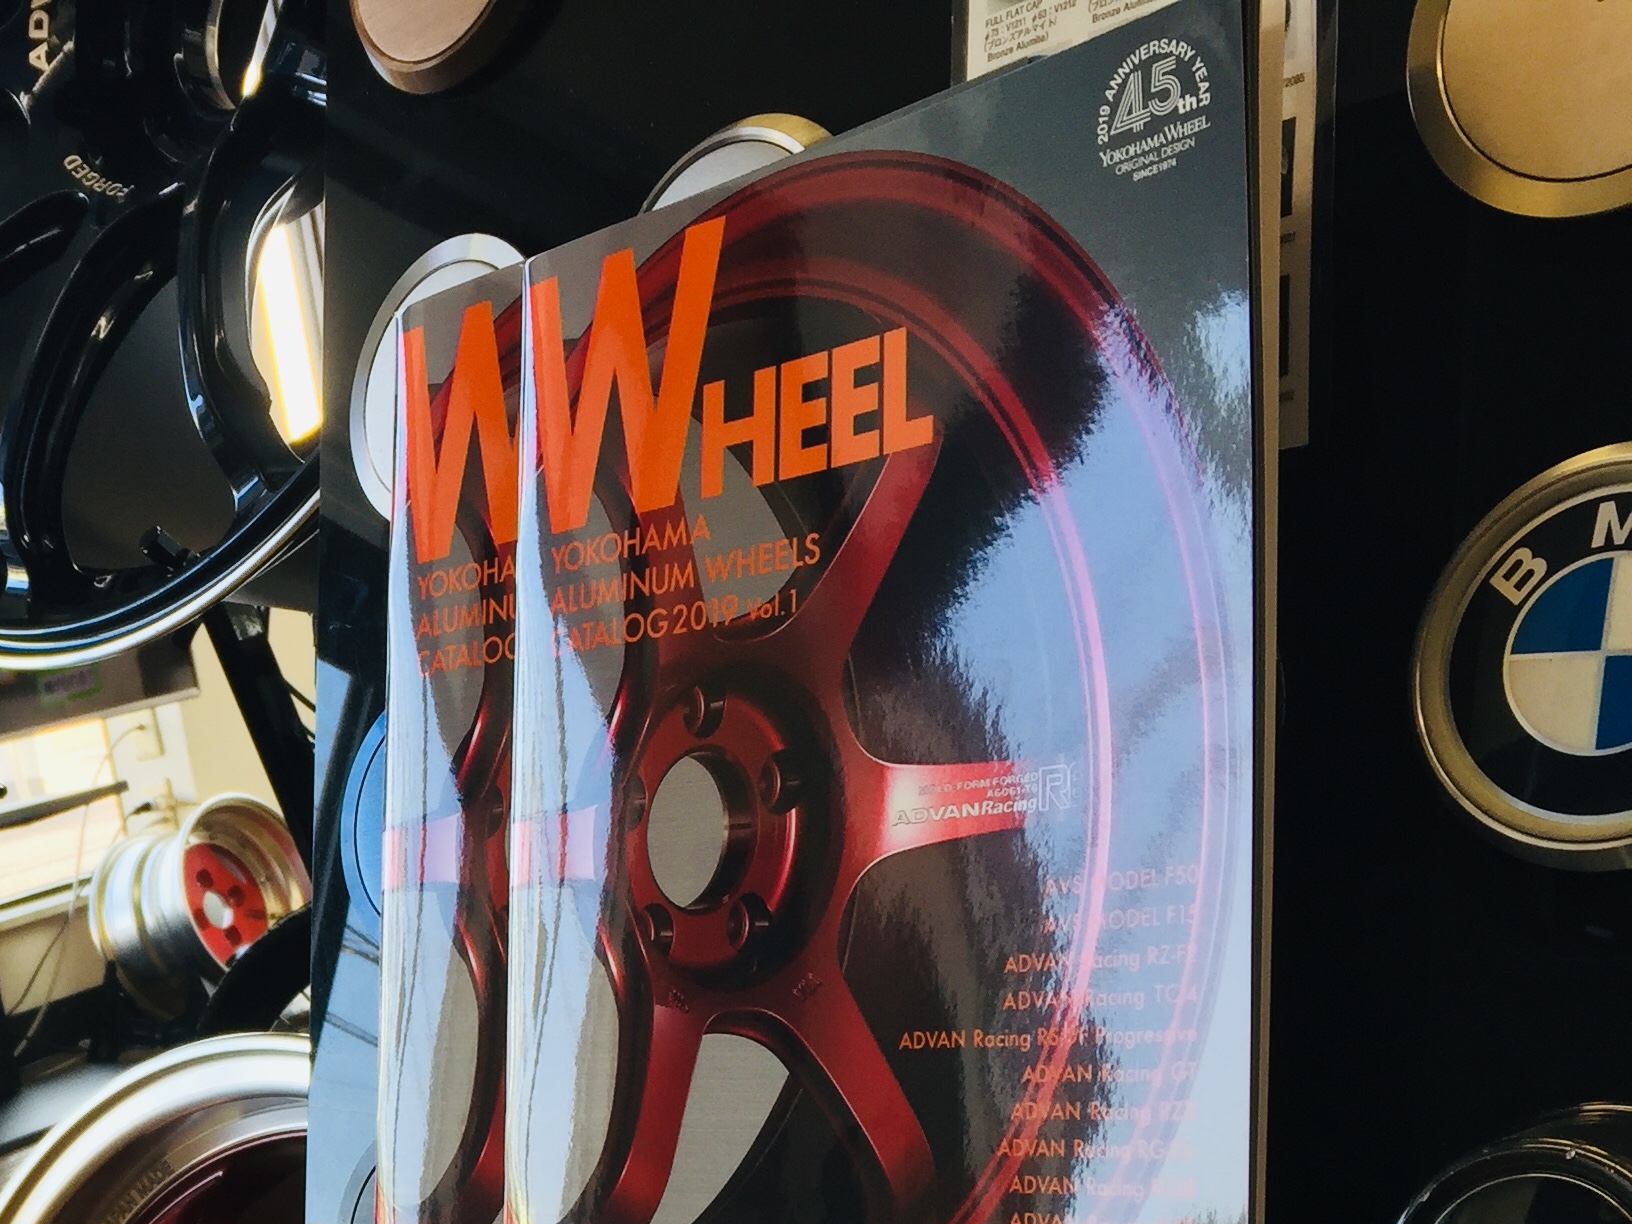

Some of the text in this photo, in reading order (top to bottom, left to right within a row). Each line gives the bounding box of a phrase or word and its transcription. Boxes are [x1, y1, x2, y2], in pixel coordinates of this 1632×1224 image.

[985, 17, 1004, 28] FULL
[1006, 5, 1025, 20] FLAT
[1097, 38, 1211, 145] 2019 ANNIVERSARY YEAR
[1099, 115, 1211, 168] YOKOHAMA WHEEL
[1116, 137, 1196, 175] ORIGINAL DESIGN
[64, 155, 134, 203] FORGED
[529, 215, 934, 533] WHEEL
[551, 513, 712, 574] YOKOHAMA
[549, 532, 821, 616] ALUMINUM WHEELS
[991, 772, 1038, 788] FORGED
[892, 800, 980, 827] ADVAN
[1003, 952, 1070, 974] ADVAN
[899, 1029, 965, 1050] ADVAN
[973, 1027, 1031, 1051] Racing
[1020, 1063, 1093, 1083] ADVAN
[1010, 1101, 1081, 1121] ADVAN
[997, 1138, 1065, 1157] ADVAN
[1073, 1138, 1131, 1164] Racing
[1009, 1175, 1076, 1195] ADVAN
